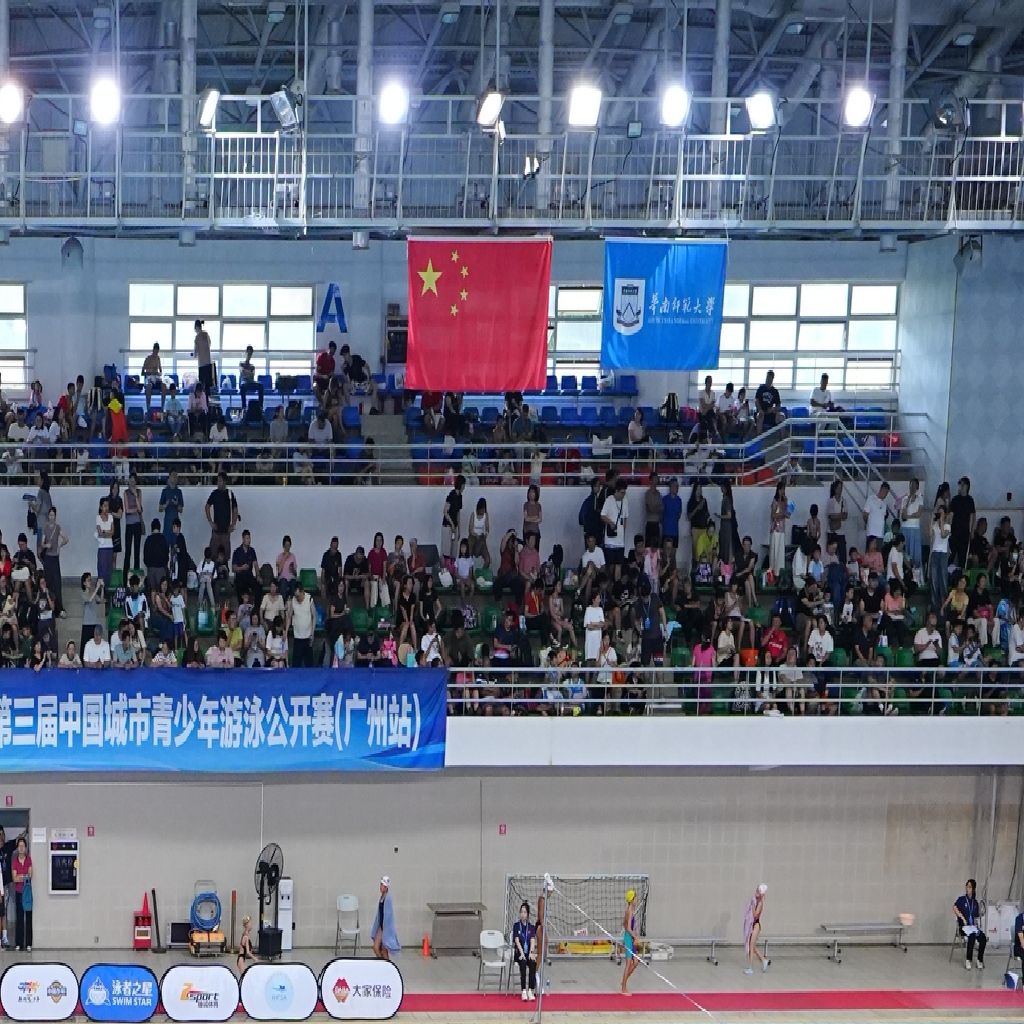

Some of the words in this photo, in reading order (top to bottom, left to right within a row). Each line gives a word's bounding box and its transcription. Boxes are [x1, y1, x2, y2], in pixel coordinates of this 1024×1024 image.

[316, 283, 349, 333] A
[111, 979, 153, 997] 泳者之星
[352, 984, 392, 999] 大家保险
[111, 997, 133, 1006] SWIM
[134, 997, 153, 1006] STAR
